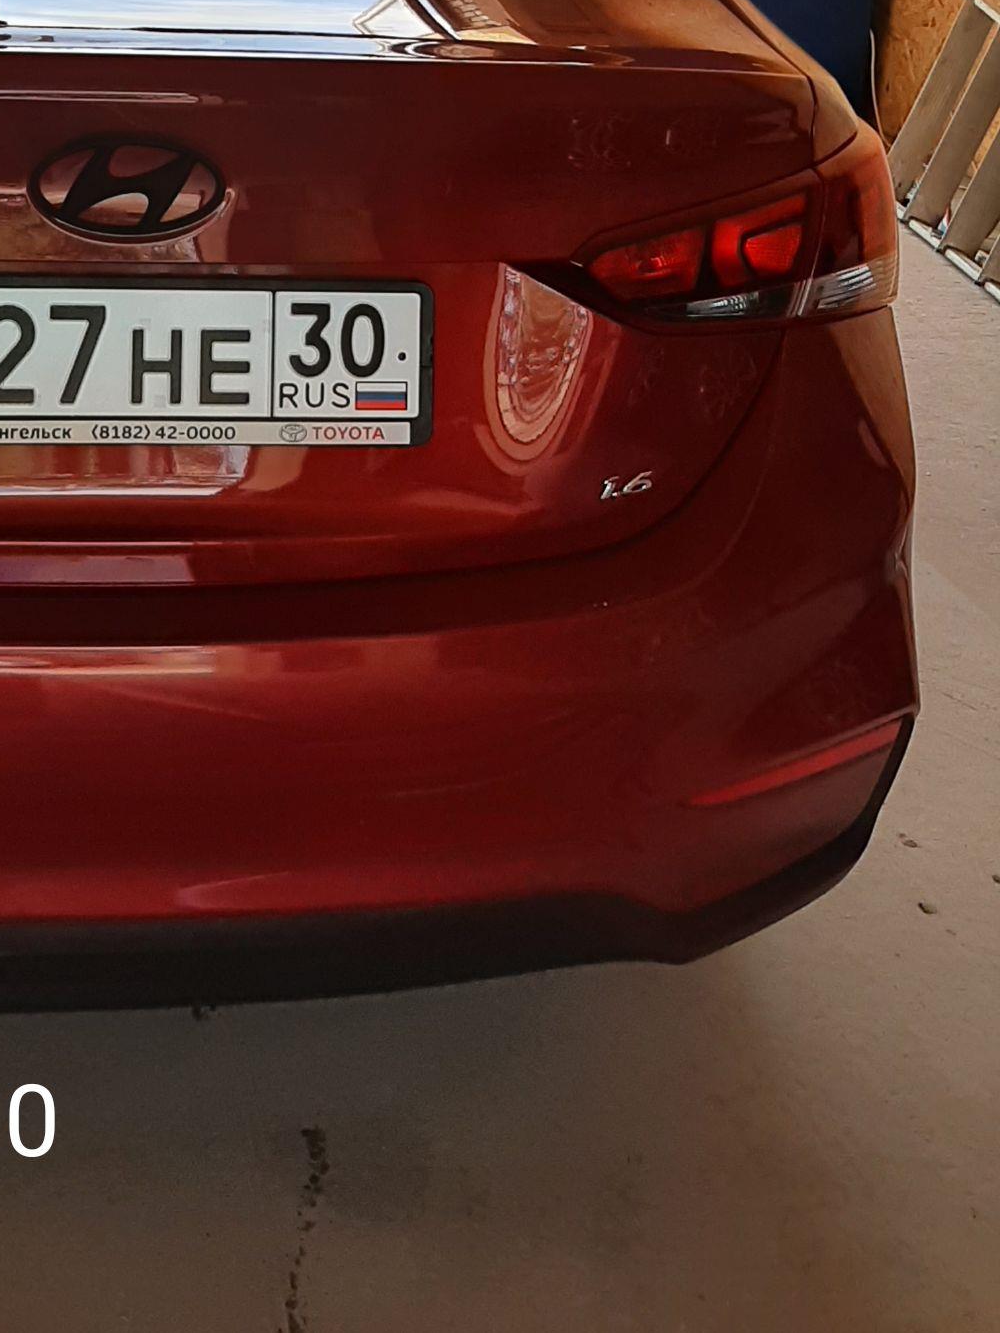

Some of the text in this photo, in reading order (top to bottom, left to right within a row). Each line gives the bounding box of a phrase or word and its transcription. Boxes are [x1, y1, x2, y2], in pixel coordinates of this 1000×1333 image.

[289, 302, 385, 378] 30
[279, 382, 352, 410] RUS
[91, 424, 151, 441] (8182)
[155, 425, 237, 440] 42-0000
[312, 426, 385, 441] TOYOTA
[600, 470, 653, 499] 1.6
